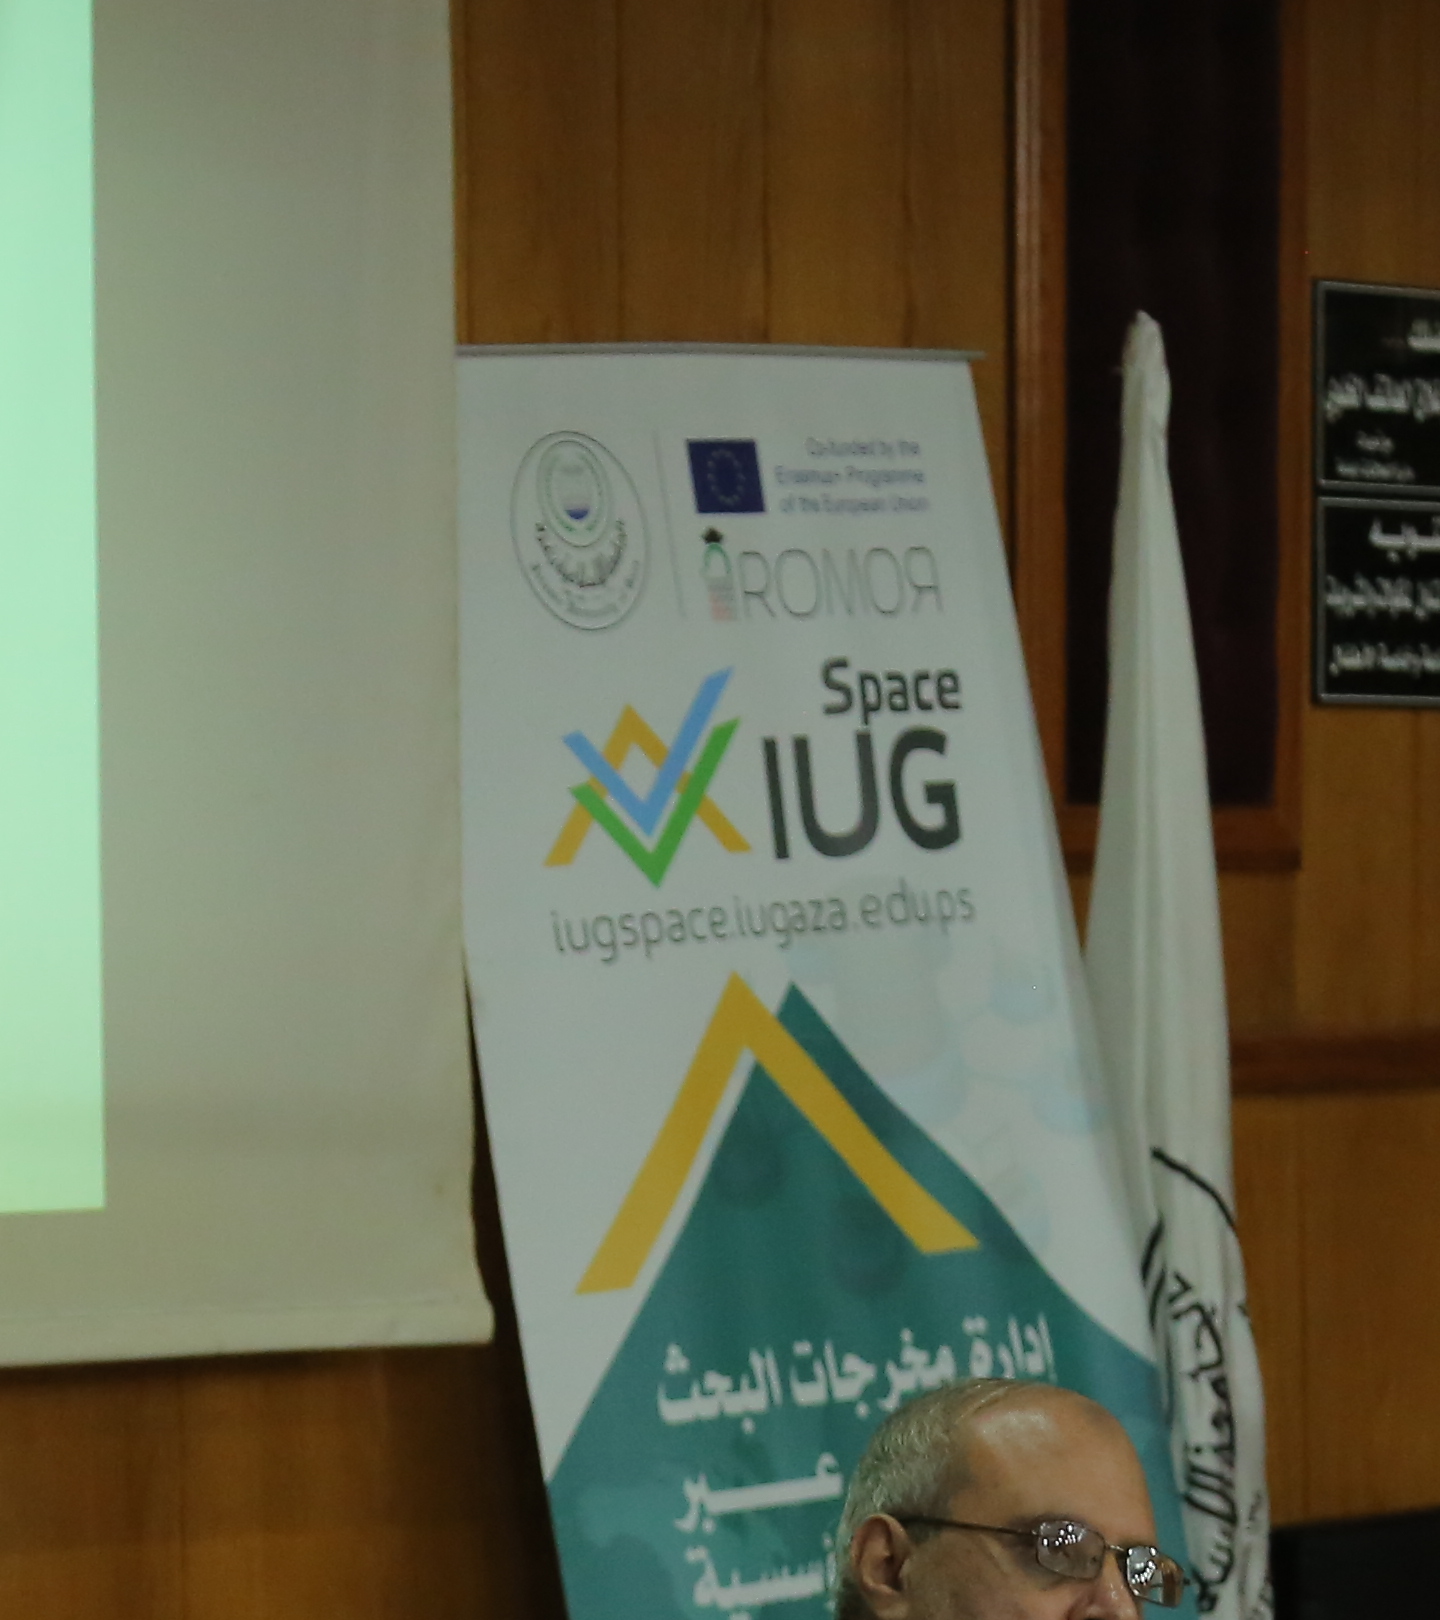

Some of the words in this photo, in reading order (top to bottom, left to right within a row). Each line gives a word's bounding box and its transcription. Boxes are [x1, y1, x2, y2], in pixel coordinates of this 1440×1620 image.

[822, 657, 963, 723] Space
[761, 726, 962, 860] IUG
[657, 1343, 784, 1434] البحث
